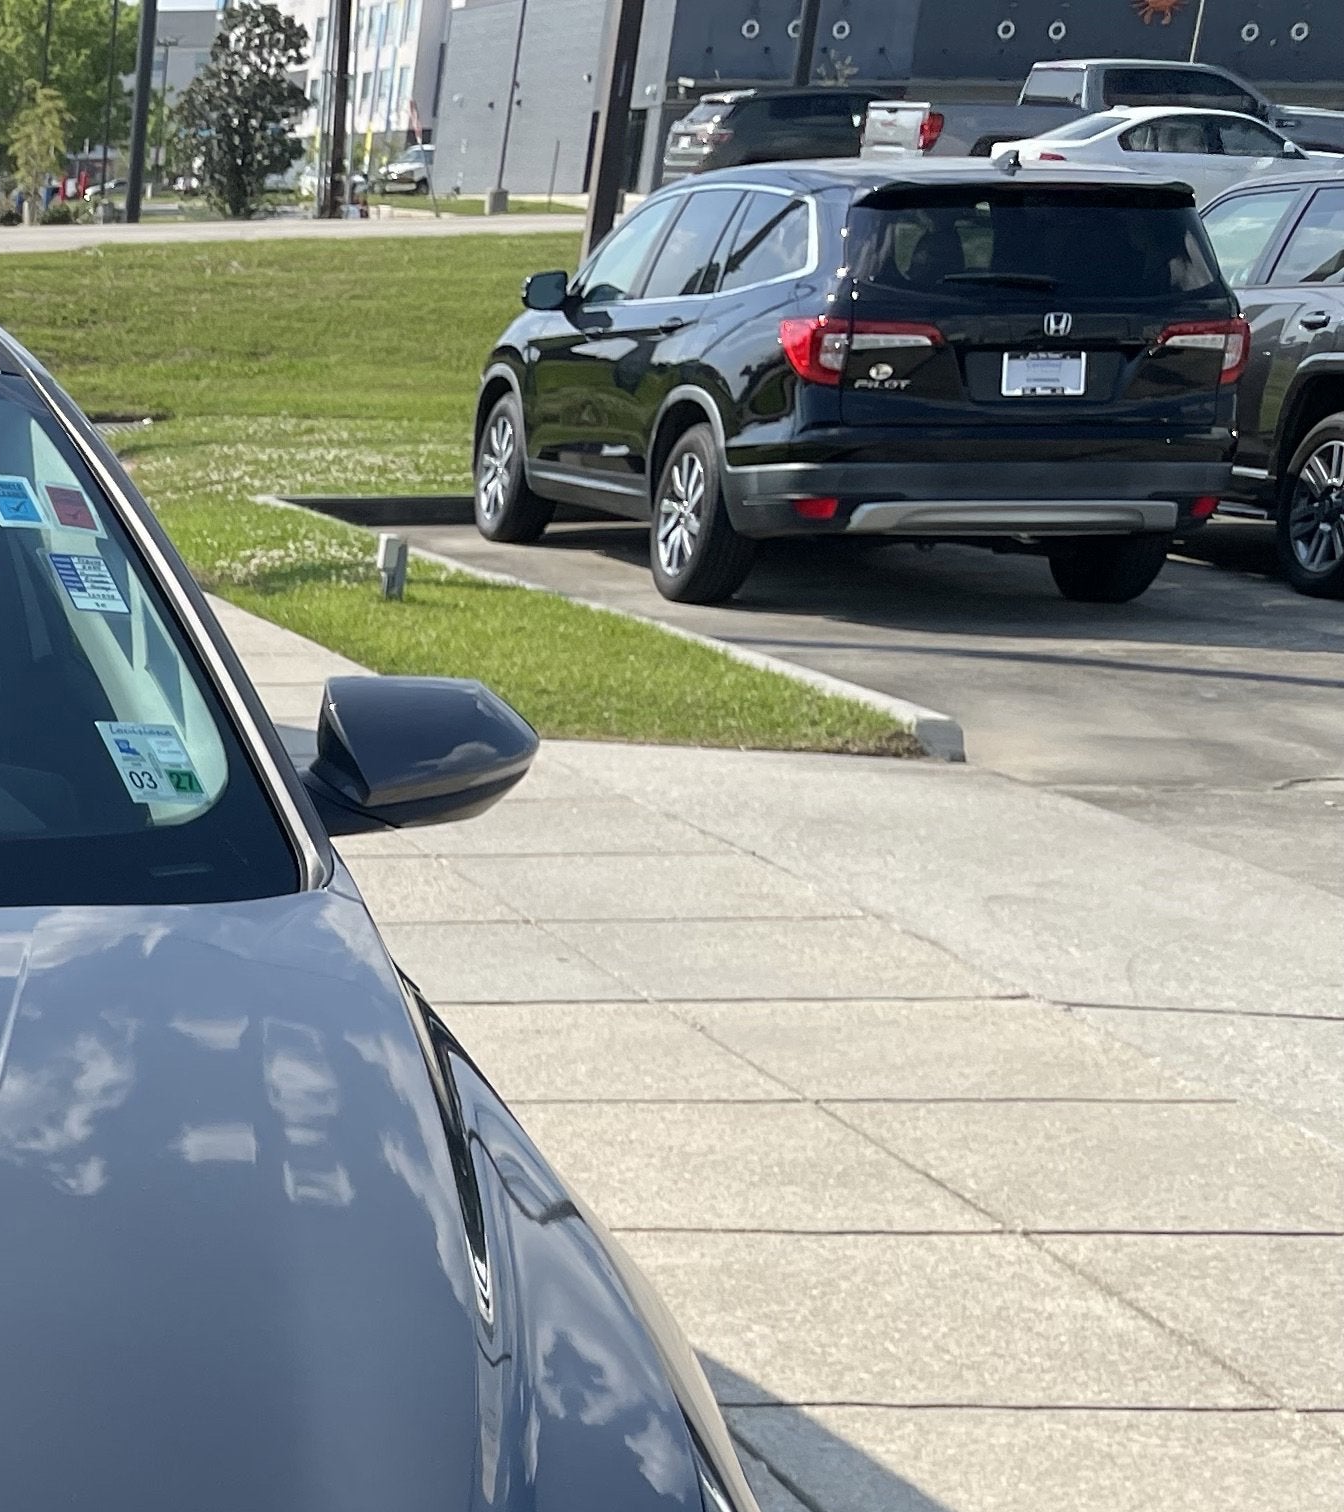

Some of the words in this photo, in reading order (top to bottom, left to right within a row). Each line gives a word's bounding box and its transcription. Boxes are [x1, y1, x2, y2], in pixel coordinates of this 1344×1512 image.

[853, 378, 912, 389] PILOT
[108, 723, 173, 737] Louisiana
[129, 771, 158, 790] 03
[169, 772, 194, 790] 27
